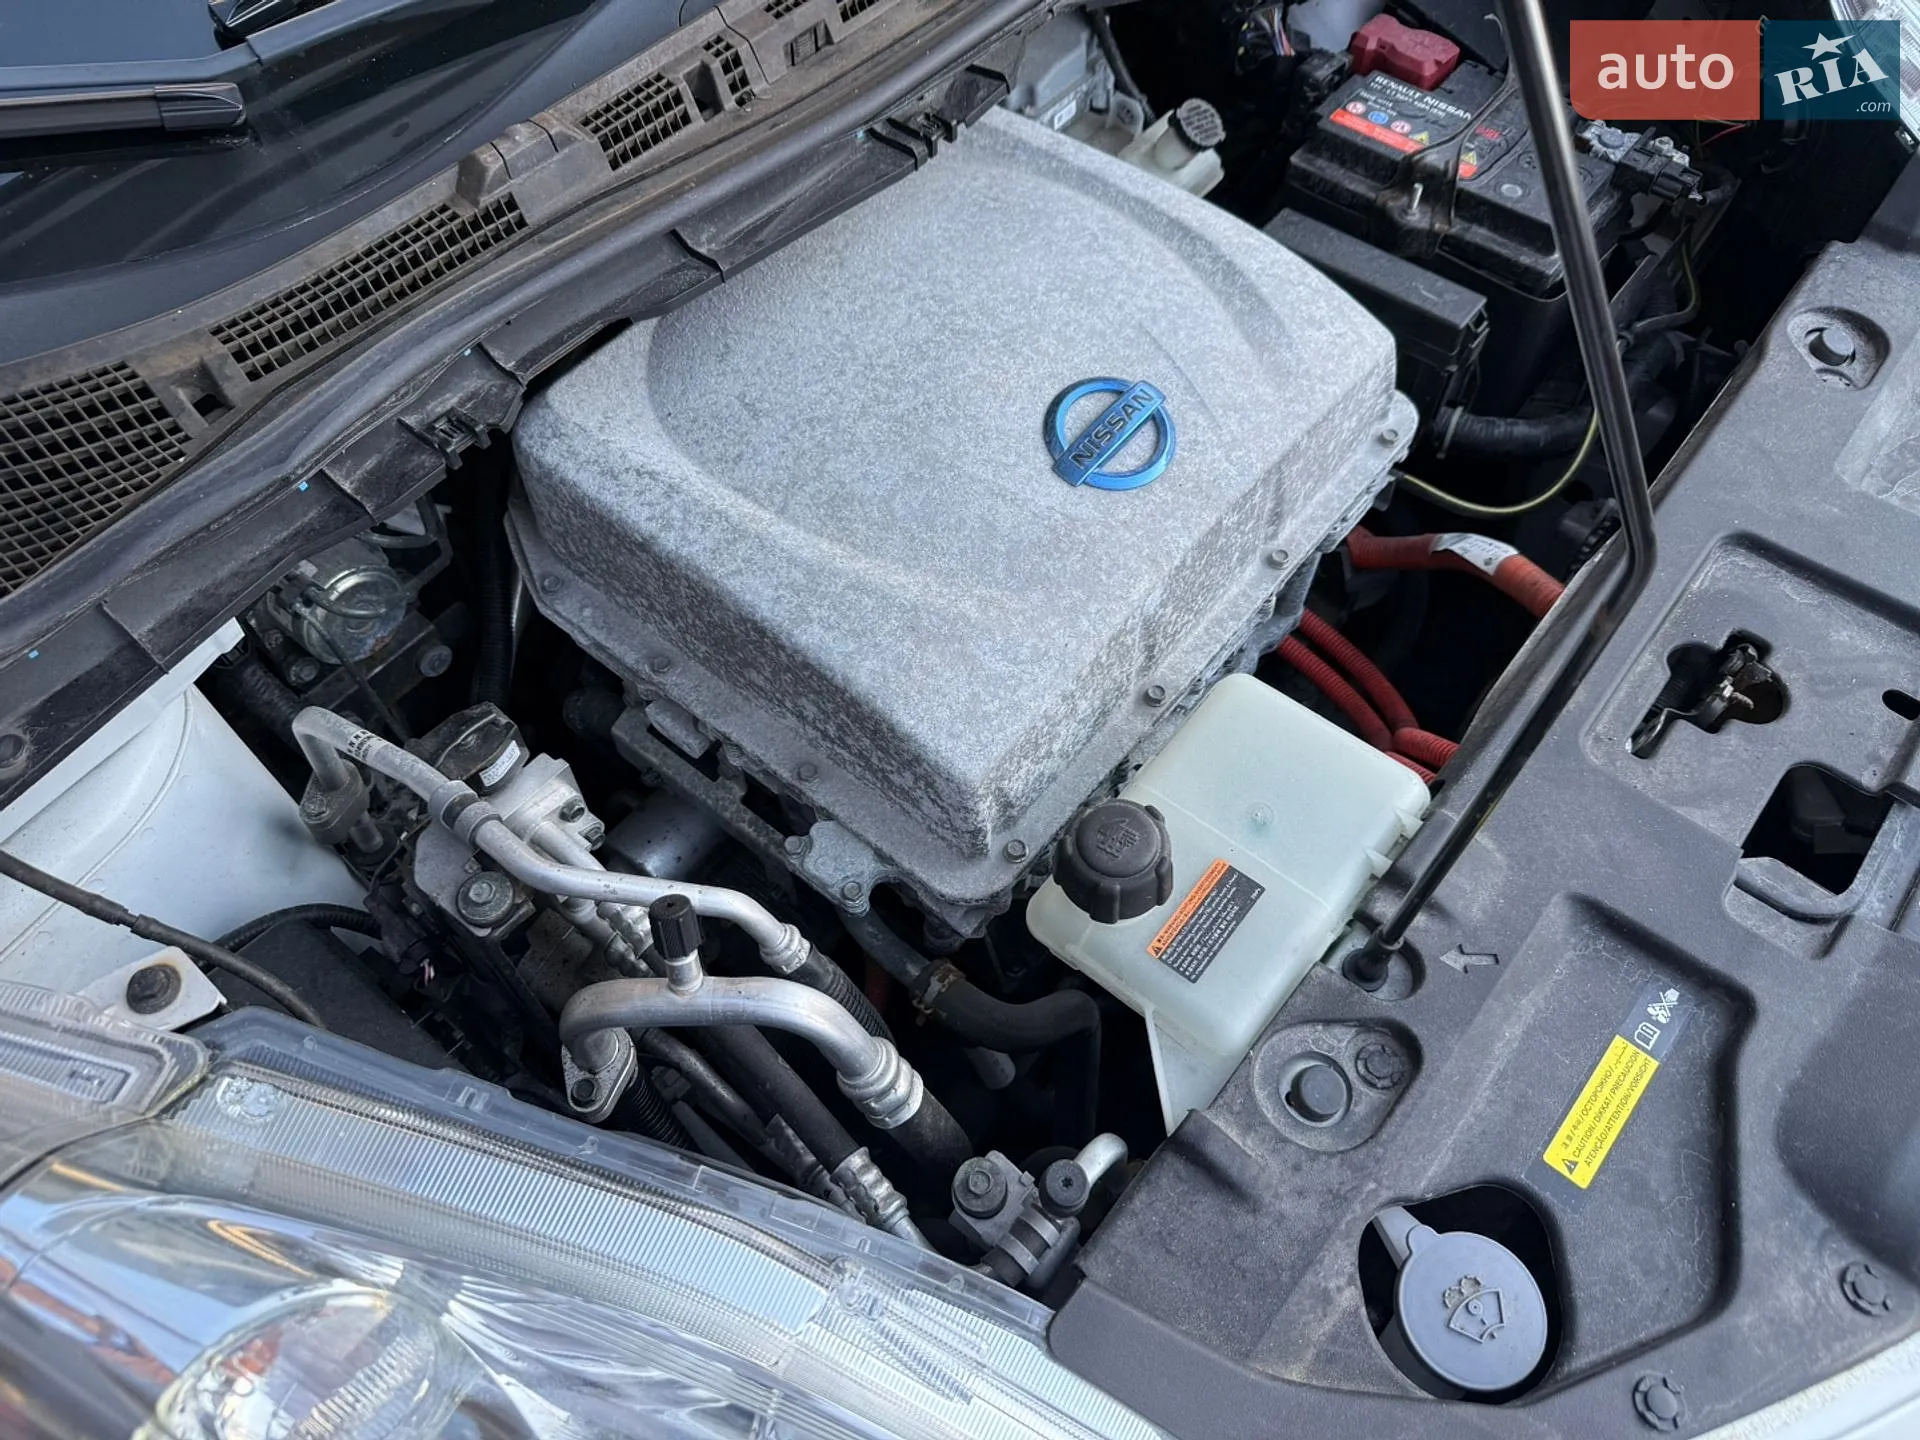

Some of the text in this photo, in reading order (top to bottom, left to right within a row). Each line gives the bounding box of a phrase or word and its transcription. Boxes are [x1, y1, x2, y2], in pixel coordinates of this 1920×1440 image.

[1375, 75, 1424, 100] RENAULT
[1424, 95, 1472, 120] NISSAN
[1069, 388, 1154, 470] NISSAN
